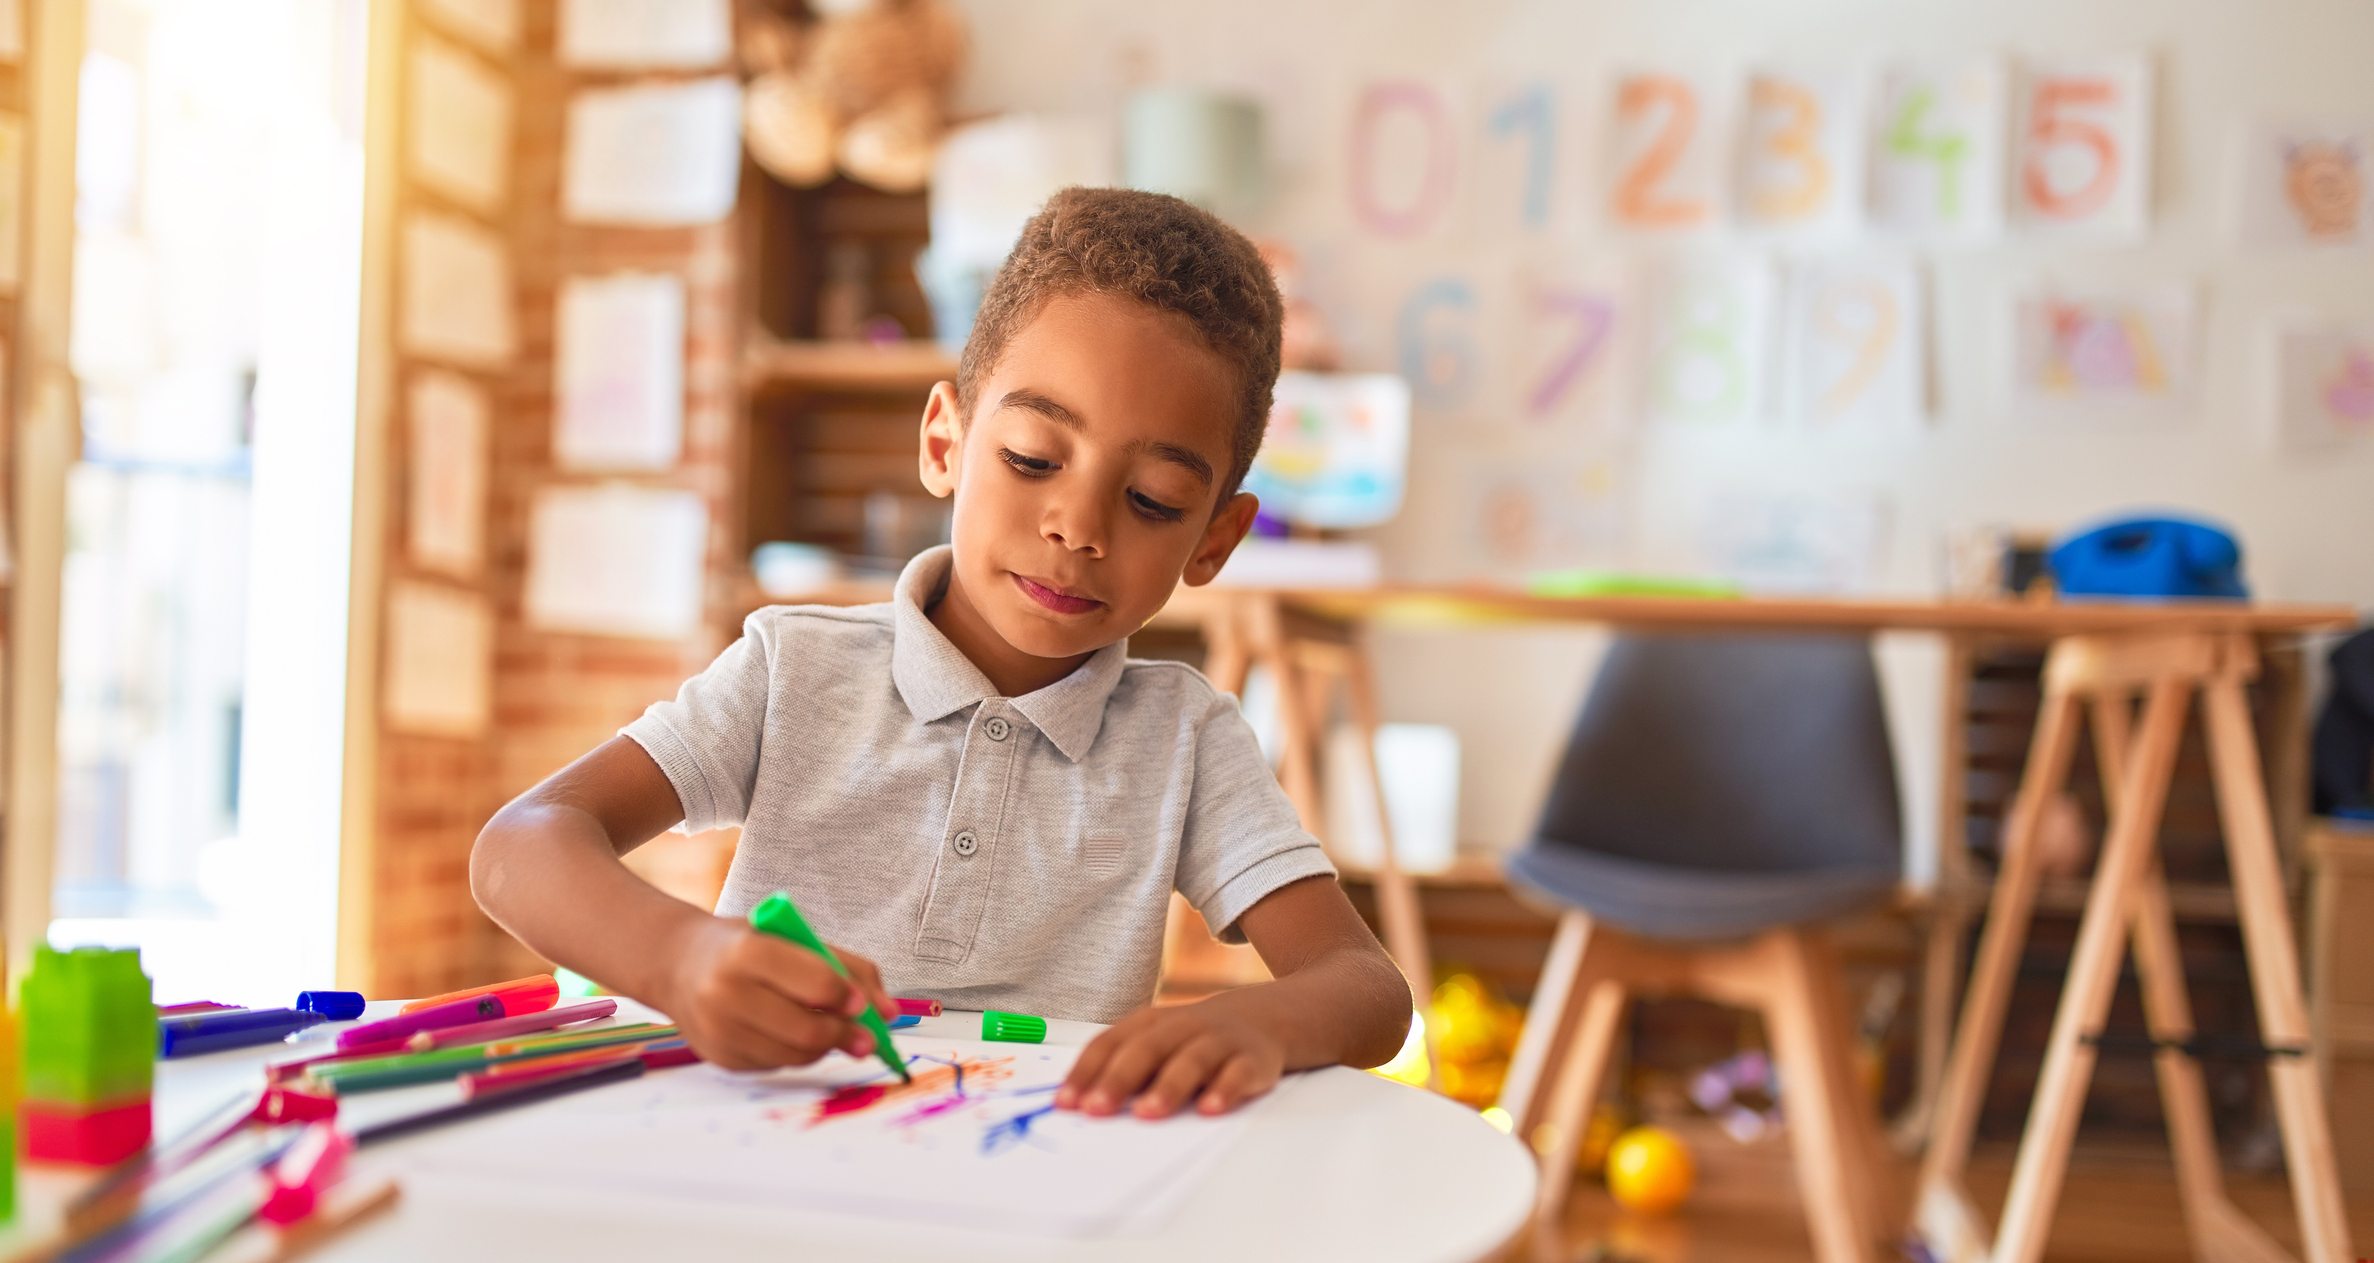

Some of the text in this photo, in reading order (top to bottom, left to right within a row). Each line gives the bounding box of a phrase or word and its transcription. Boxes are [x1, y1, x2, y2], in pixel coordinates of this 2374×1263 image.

[1348, 80, 1456, 240] 0
[1490, 86, 1553, 225] 1
[1611, 77, 1709, 227] 2
[1748, 78, 1831, 222] 3
[1887, 88, 1970, 220] 4
[2024, 79, 2119, 220] 5
[1399, 280, 1479, 407] 6
[1528, 290, 1615, 414] 7
[1659, 279, 1749, 422] 8
[1817, 281, 1902, 415] 9
